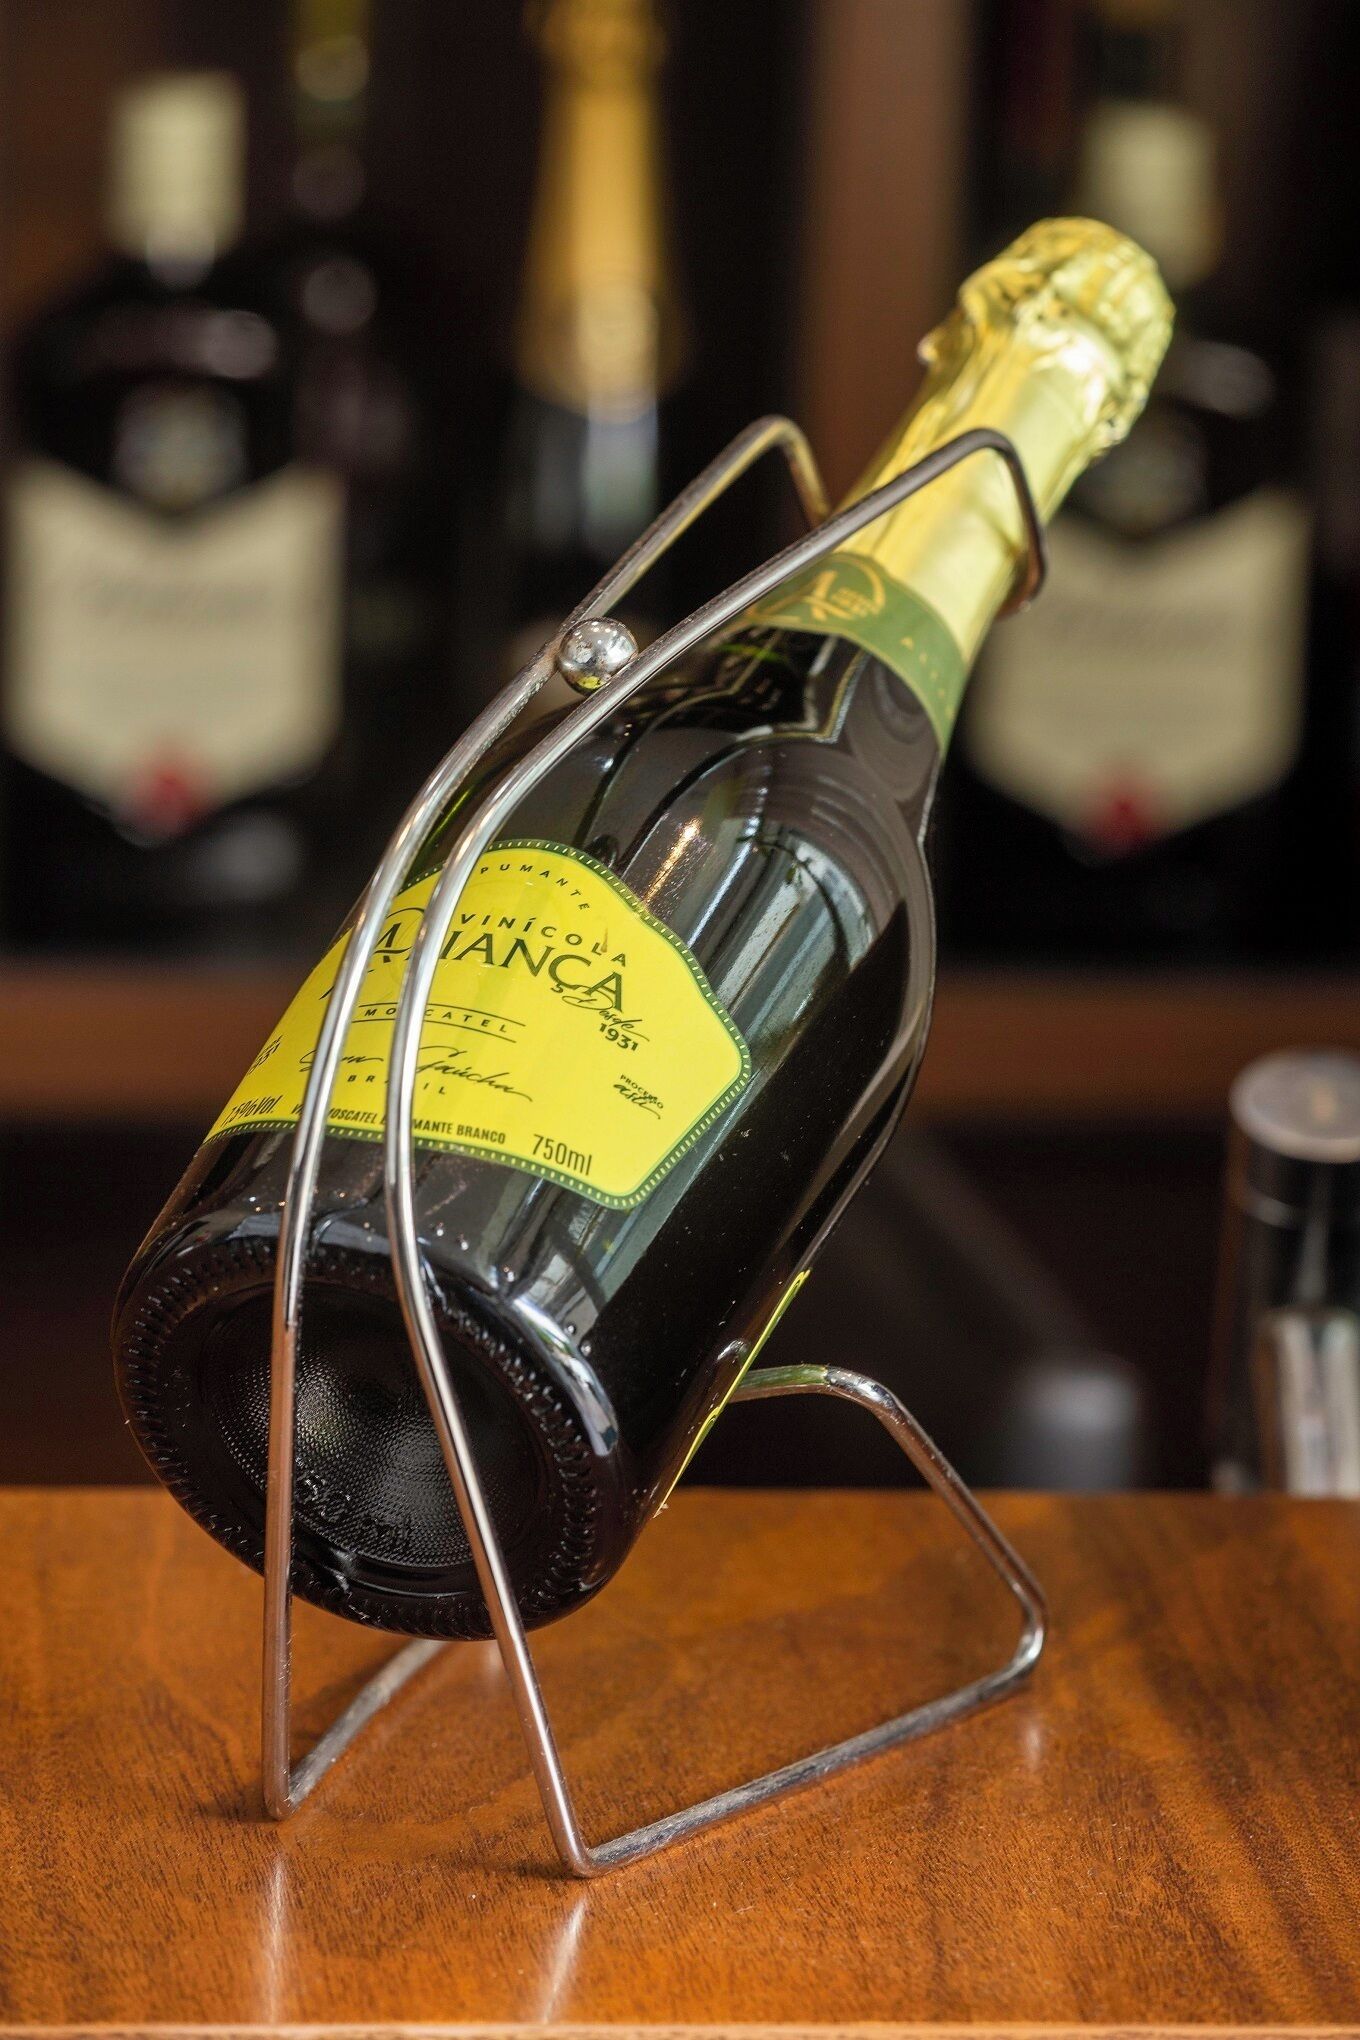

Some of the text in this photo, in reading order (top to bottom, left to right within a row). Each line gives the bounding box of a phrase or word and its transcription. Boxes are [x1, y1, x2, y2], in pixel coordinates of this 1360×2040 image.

[480, 863, 591, 911] PUMANTE
[460, 913, 627, 968] VINÍCOLA
[364, 1006, 507, 1033] MOCATEL
[599, 1022, 639, 1052] 1931
[346, 1074, 447, 1095] BRIL
[456, 1124, 507, 1145] BRANCO
[531, 1133, 593, 1177] 750ml
